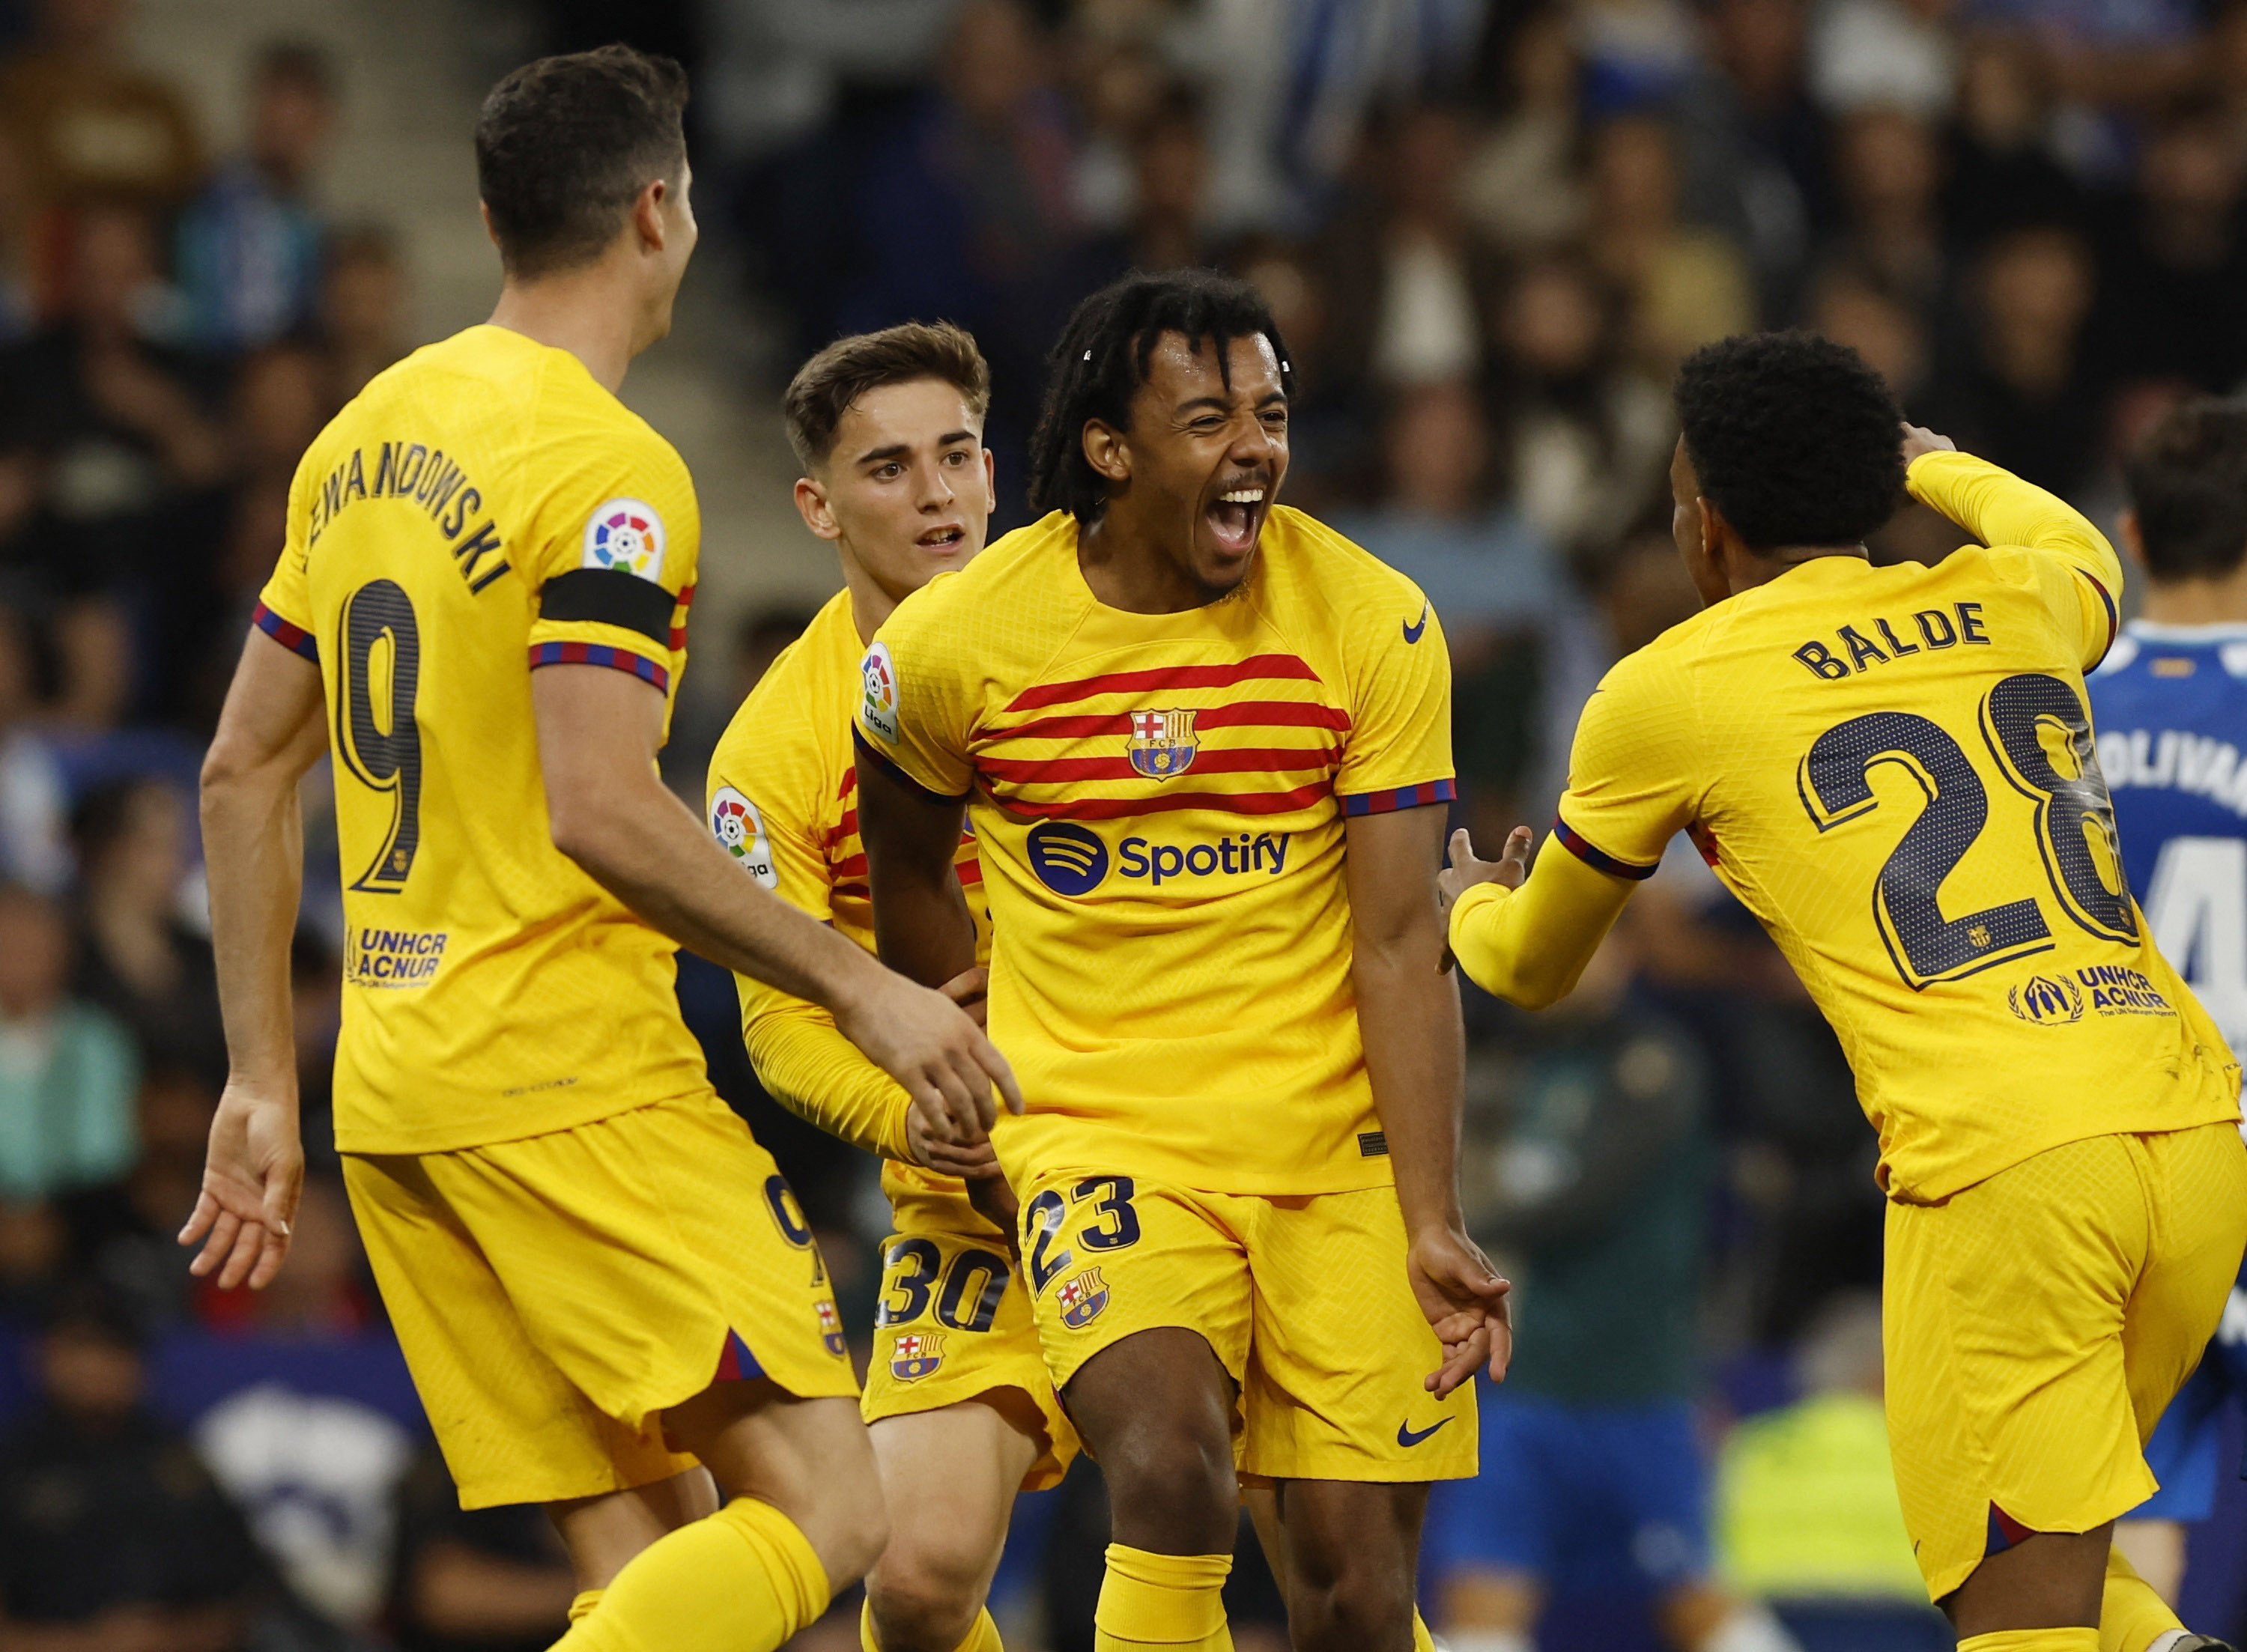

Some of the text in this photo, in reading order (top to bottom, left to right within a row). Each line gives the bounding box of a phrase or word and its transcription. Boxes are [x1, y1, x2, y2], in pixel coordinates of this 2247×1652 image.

[1791, 602, 1991, 681] BALDE
[337, 578, 421, 894] 9
[864, 705, 892, 735] Liga
[2096, 728, 2247, 820] OLIVA
[1118, 832, 1291, 886] Spotify
[1796, 672, 2141, 992] 28
[358, 953, 440, 979] ACNUR
[360, 929, 447, 955] UNHCR
[2075, 965, 2156, 992] UNHCR
[2092, 986, 2171, 1009] ACNUR
[1025, 1176, 1141, 1303] 23
[874, 1238, 1010, 1333] 30
